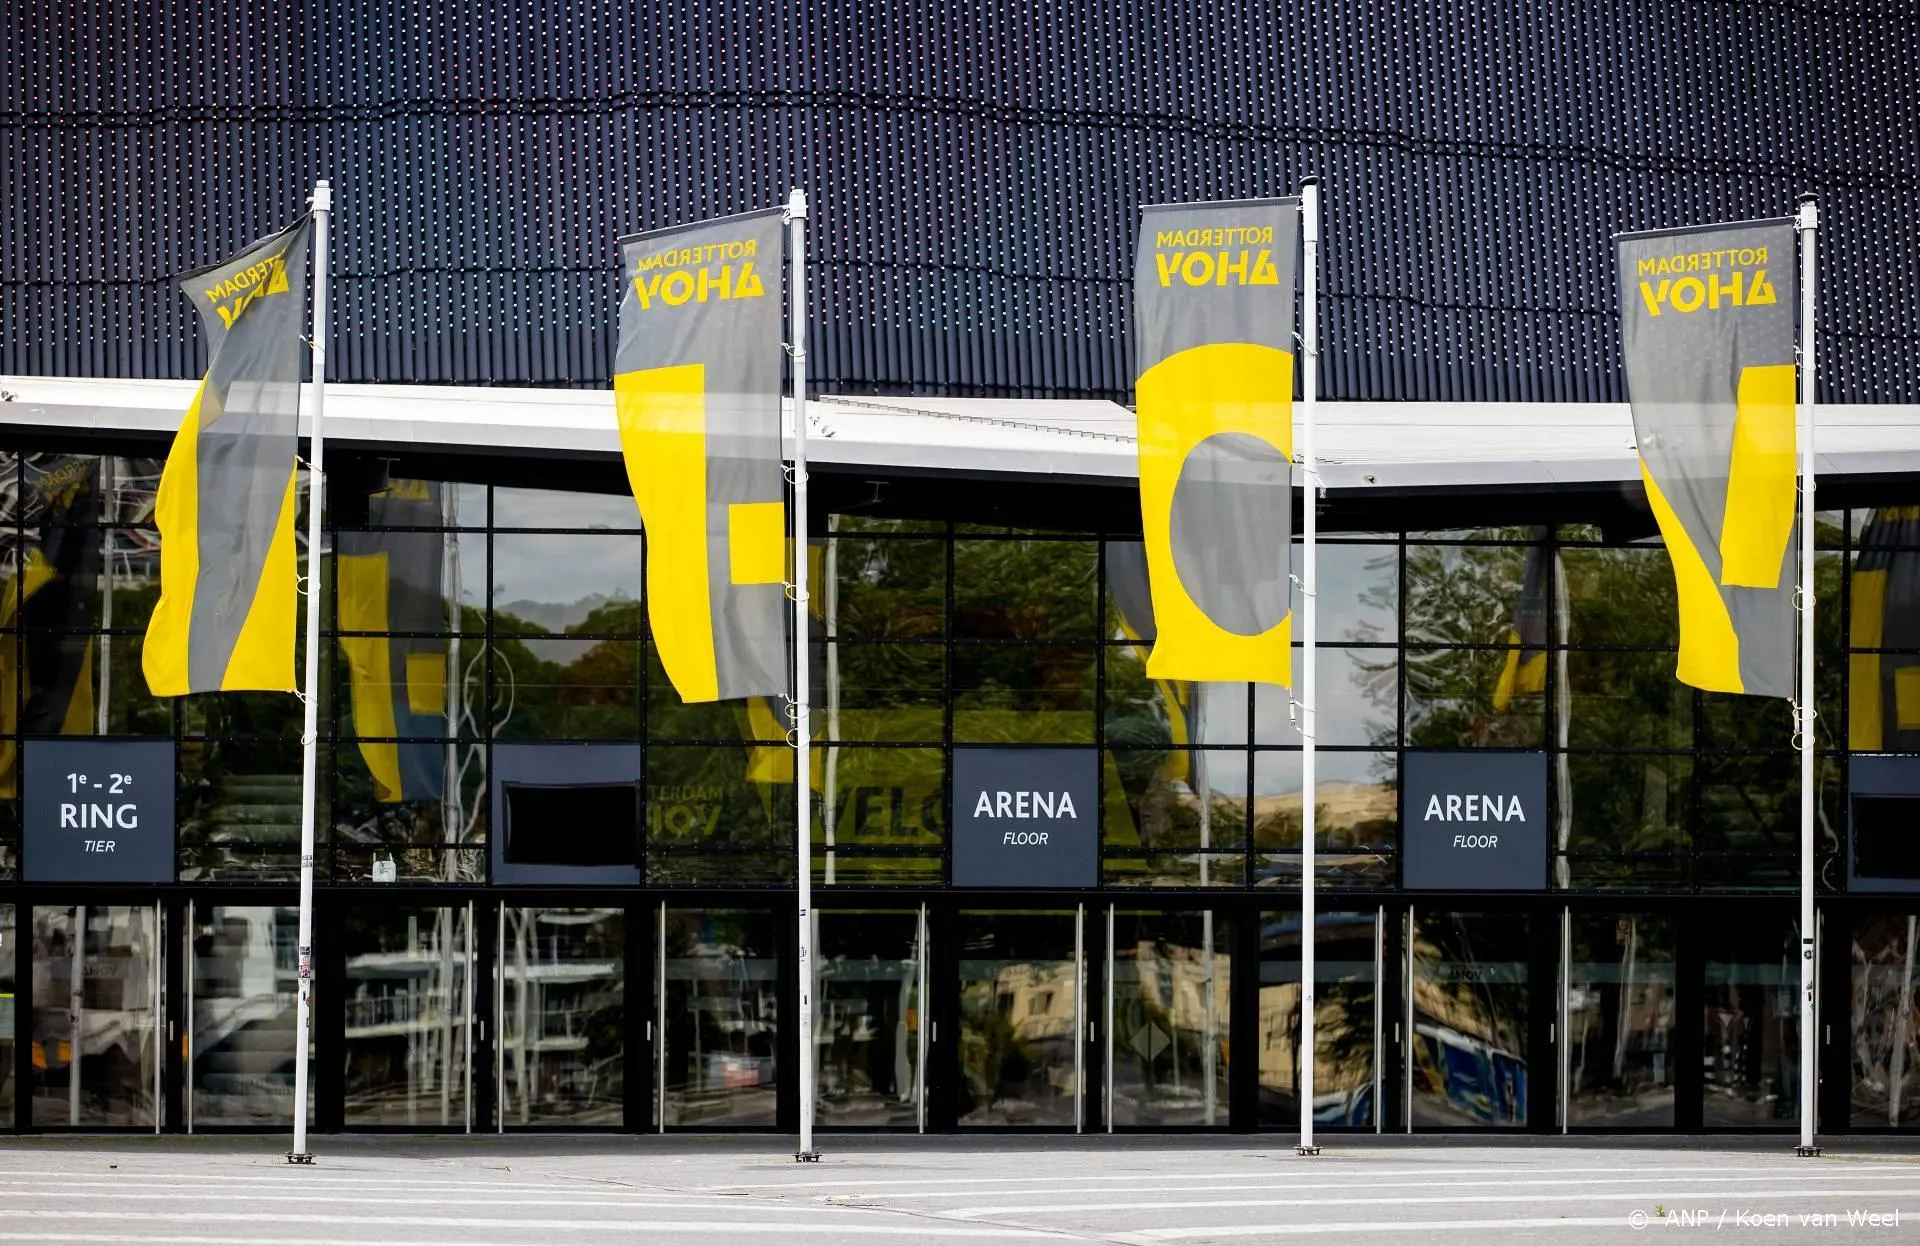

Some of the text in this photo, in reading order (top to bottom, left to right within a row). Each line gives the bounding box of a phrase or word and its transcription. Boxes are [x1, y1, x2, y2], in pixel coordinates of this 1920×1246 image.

[973, 790, 1078, 819] ARENA
[1424, 794, 1526, 822] ARENA
[60, 803, 138, 829] RING
[84, 840, 116, 853] TIER
[1003, 832, 1049, 845] FLOOR
[1453, 835, 1498, 848] FLOOR
